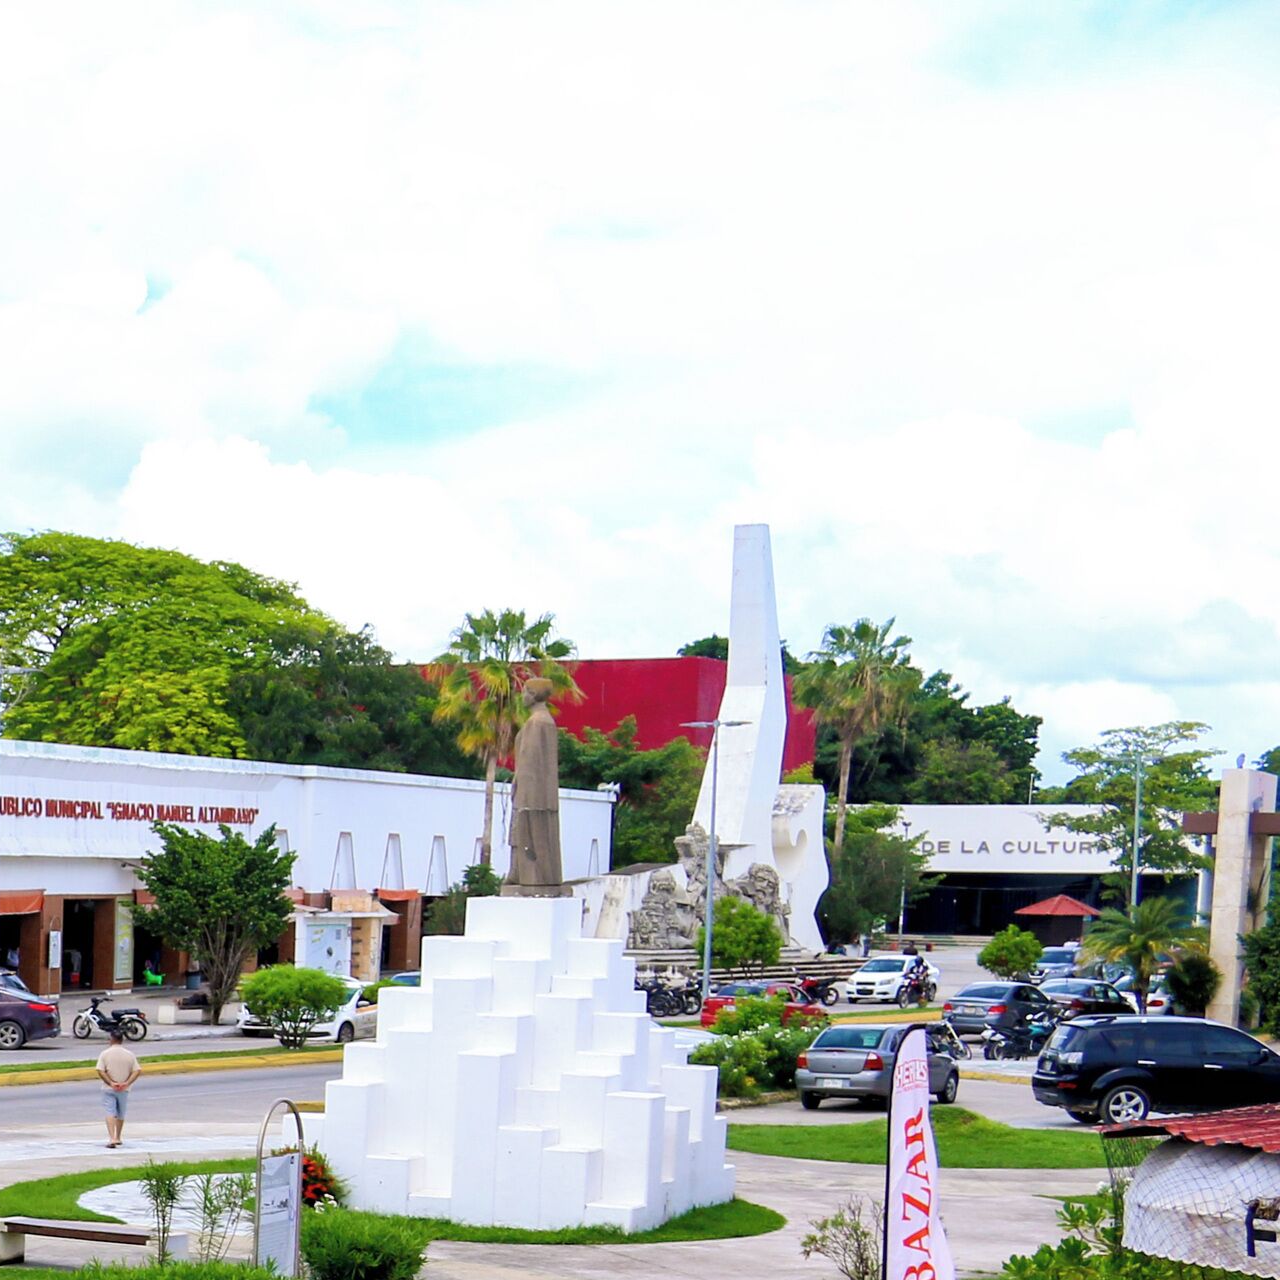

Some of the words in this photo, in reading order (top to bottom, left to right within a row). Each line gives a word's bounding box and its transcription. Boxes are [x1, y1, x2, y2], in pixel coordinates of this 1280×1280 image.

[45, 799, 104, 819] MUNICIPAL
[157, 804, 196, 822] MANUEL
[922, 840, 950, 854] DE
[961, 840, 990, 854] LA
